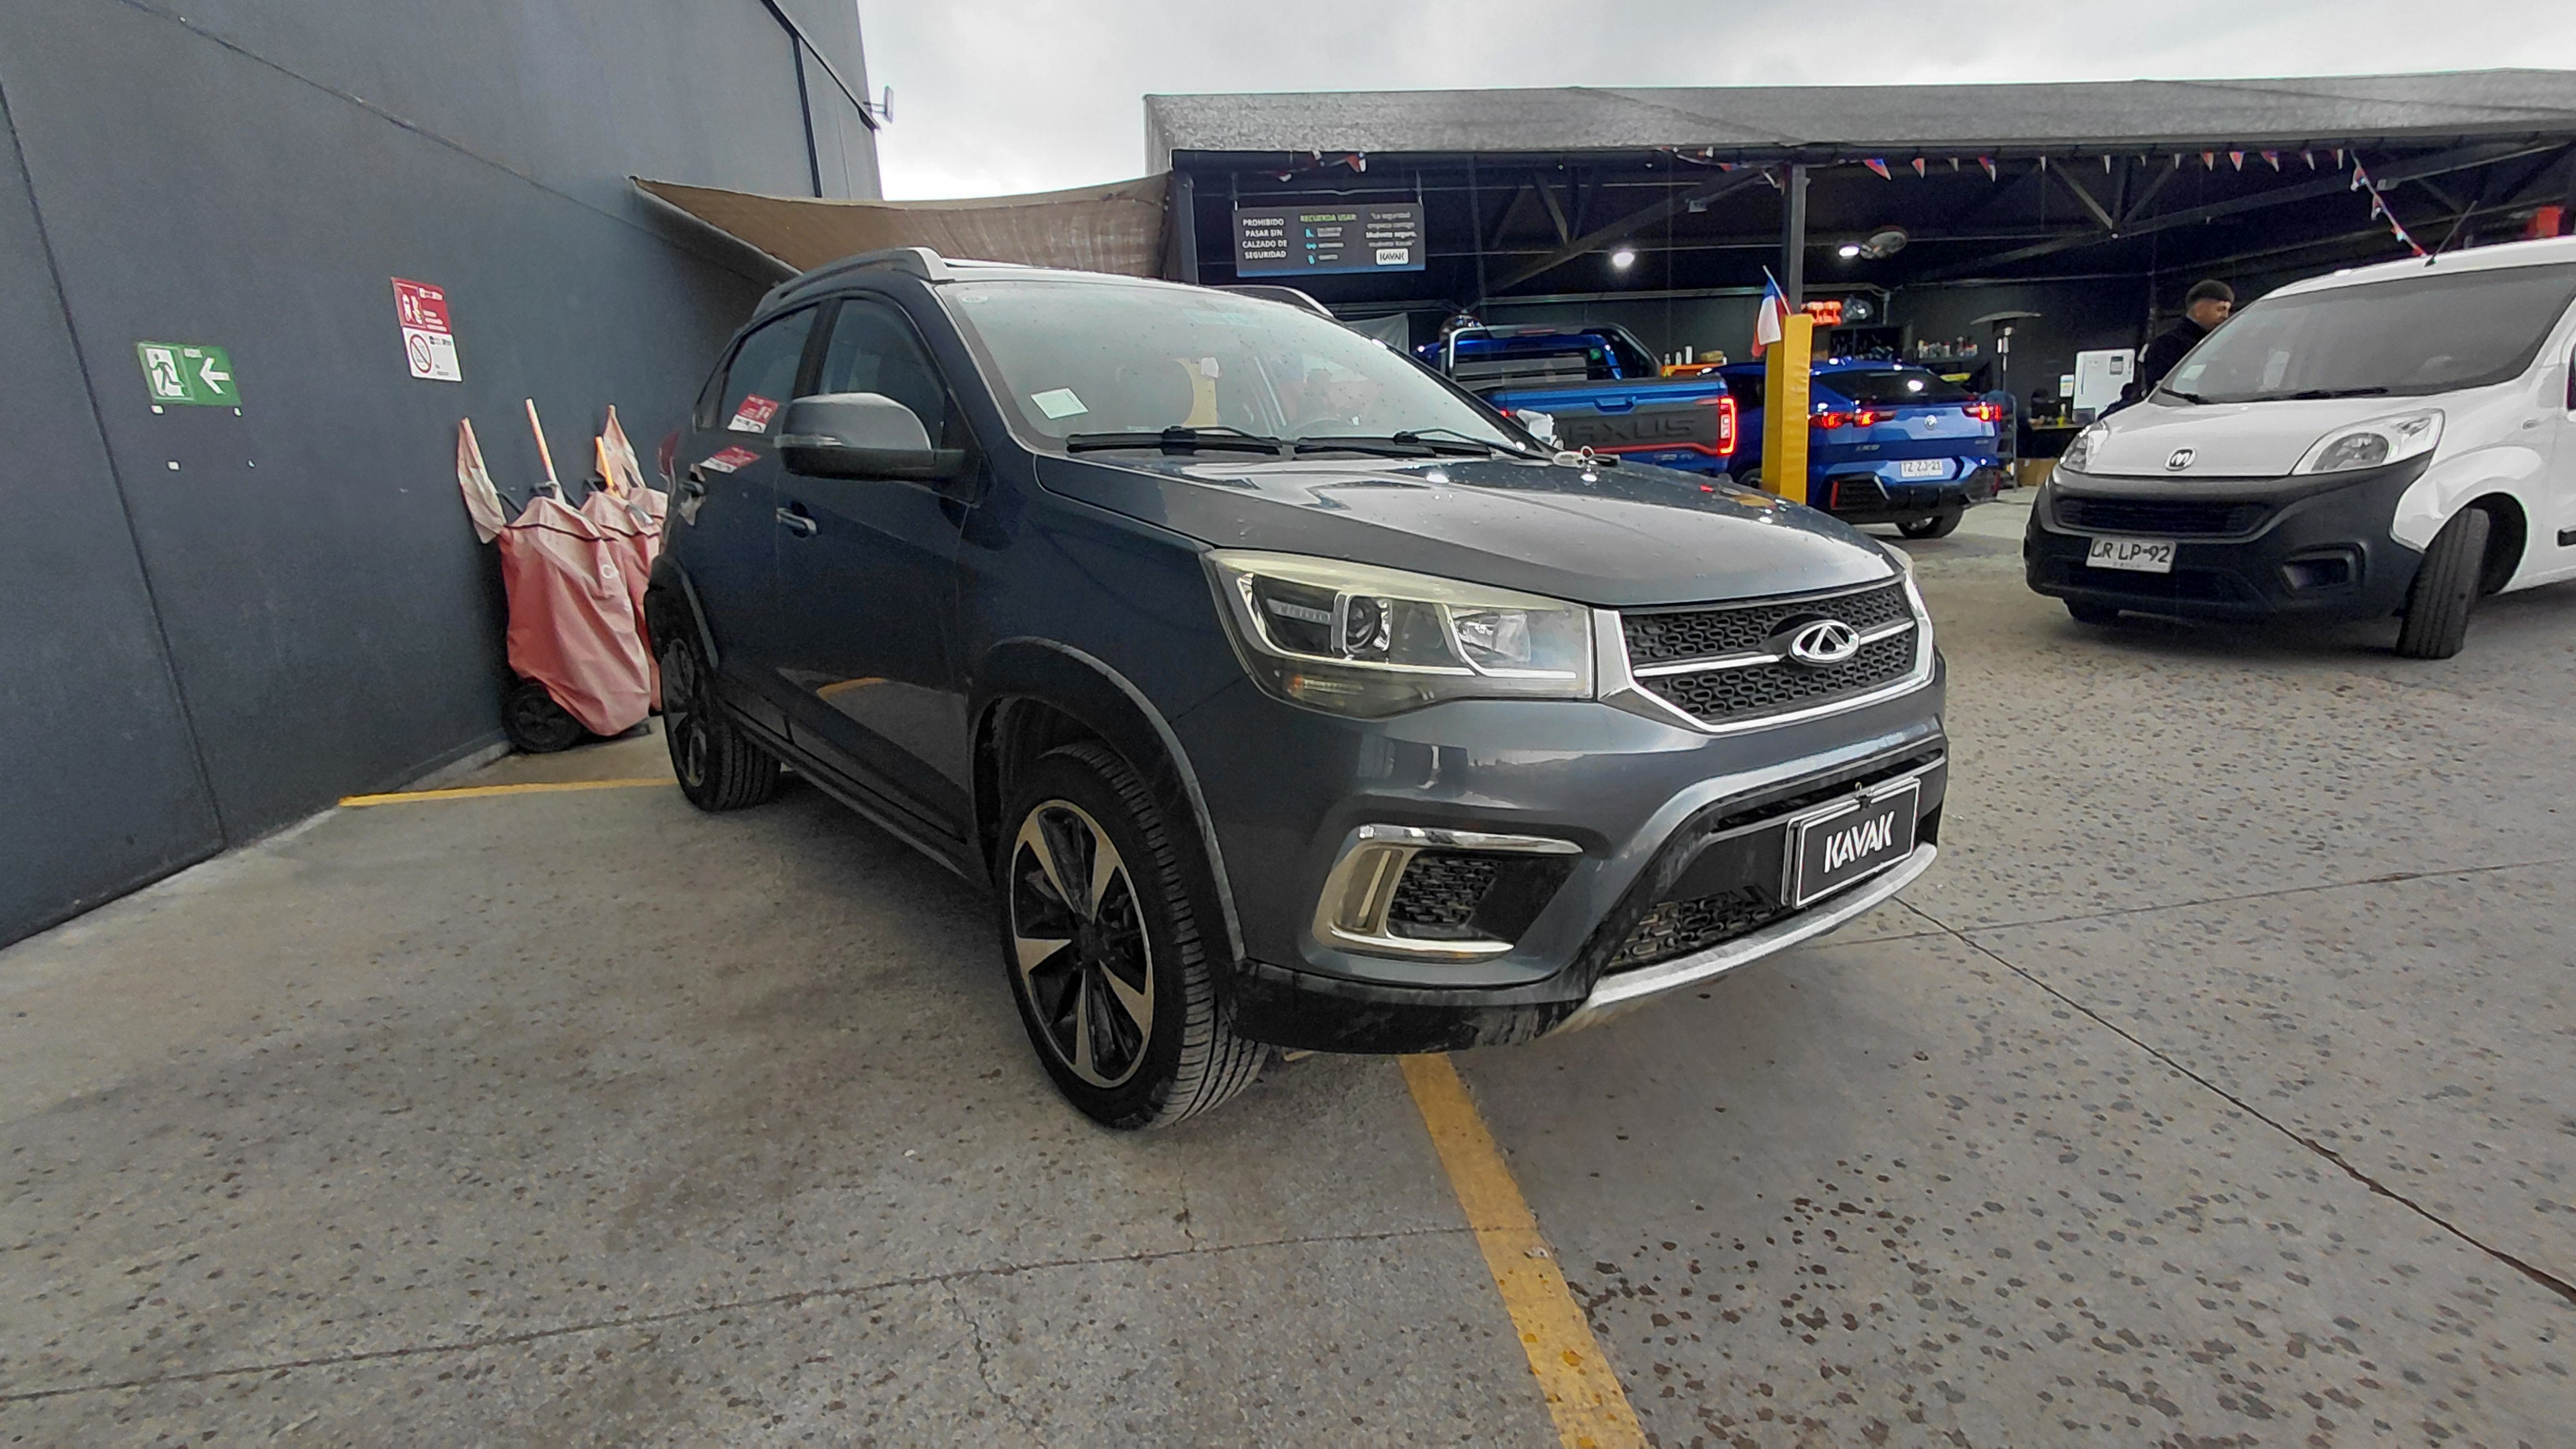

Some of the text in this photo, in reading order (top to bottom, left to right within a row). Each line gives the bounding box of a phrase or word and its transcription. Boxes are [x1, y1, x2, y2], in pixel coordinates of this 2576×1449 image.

[1242, 218, 1285, 227] PROHIBIDO
[1245, 229, 1269, 238] PASAR
[1241, 239, 1288, 249] CALZADO DE
[1244, 250, 1286, 260] SEGURIDAD
[1380, 252, 1405, 260] KAVAK
[2091, 542, 2170, 563] LR LP-92
[1823, 811, 1896, 874] KAVAK
